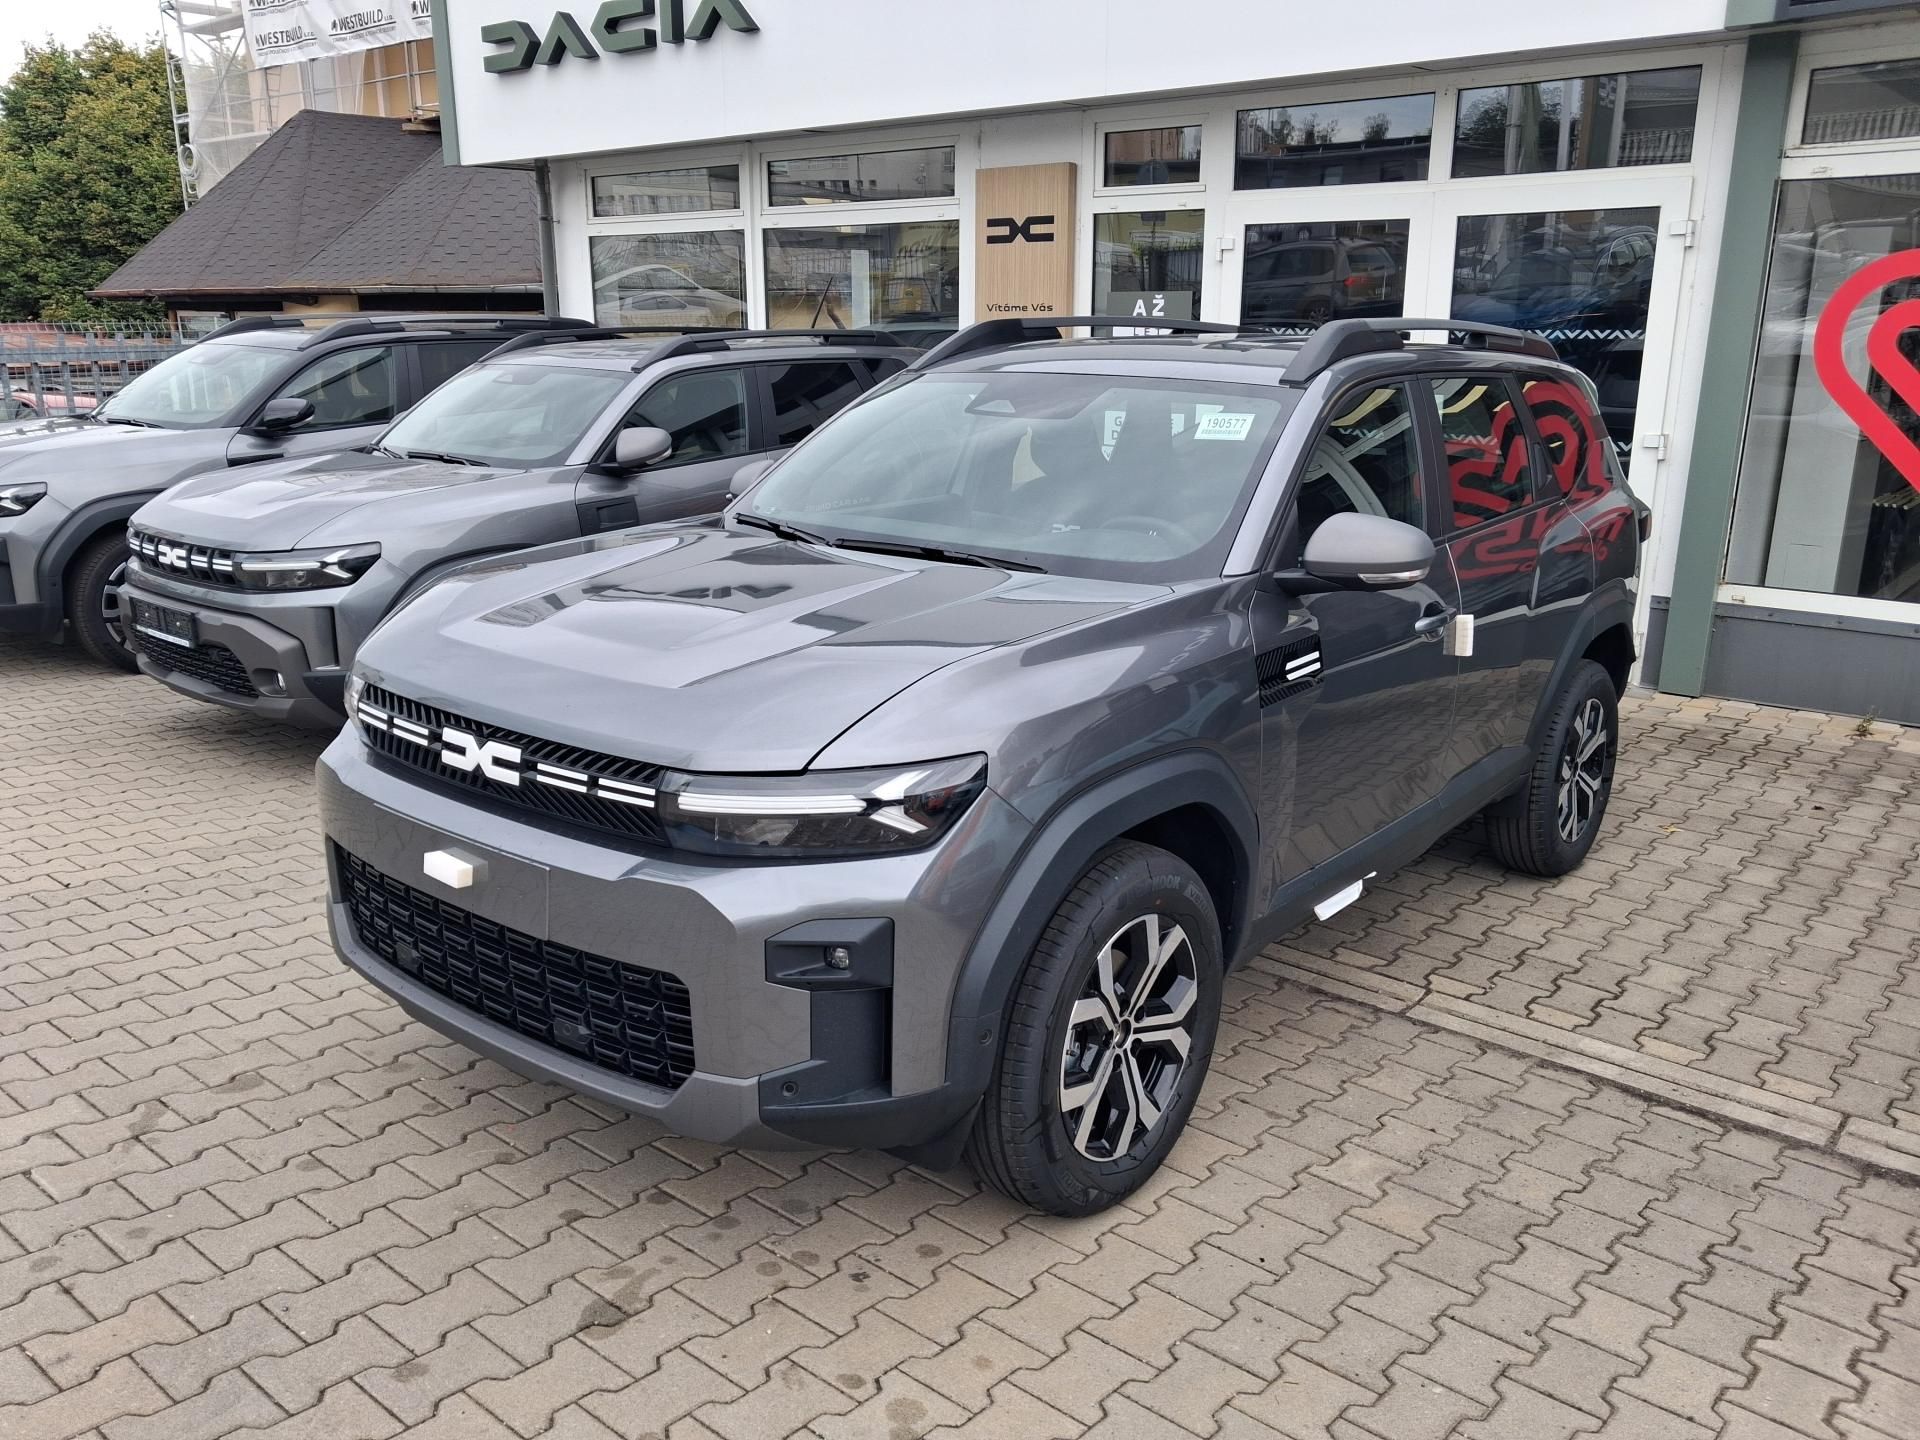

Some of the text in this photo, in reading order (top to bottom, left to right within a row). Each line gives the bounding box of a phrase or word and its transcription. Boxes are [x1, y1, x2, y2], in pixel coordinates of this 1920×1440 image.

[339, 9, 383, 31] WESTBUILD
[259, 25, 303, 46] WESTBUILD
[481, 0, 760, 73] DACIA
[986, 302, 1053, 312] Vítáme Vás
[1206, 418, 1247, 429] 190577
